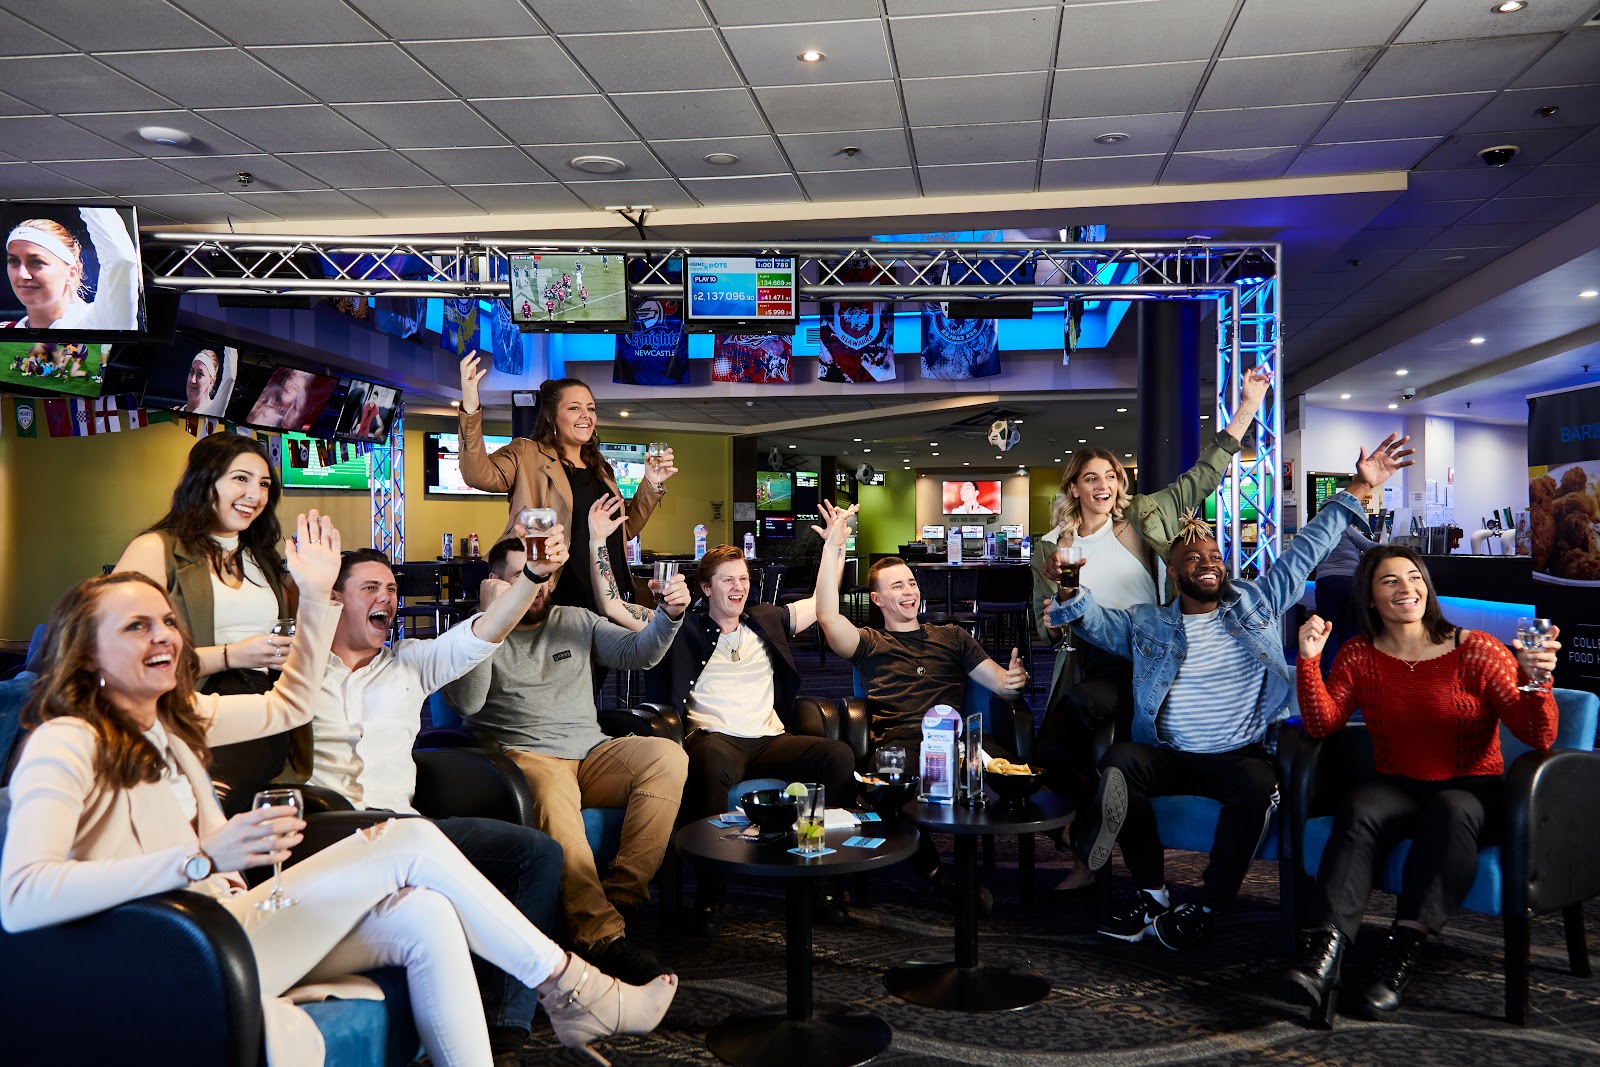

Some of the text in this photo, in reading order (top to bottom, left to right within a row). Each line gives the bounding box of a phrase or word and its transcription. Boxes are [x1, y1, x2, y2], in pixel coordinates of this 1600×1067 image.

[631, 329, 680, 350] Knights
[840, 334, 874, 347] ILLAWARRA
[634, 349, 676, 357] NEWCASTLE
[1561, 424, 1592, 442] BAR
[1569, 651, 1594, 664] FOOD
